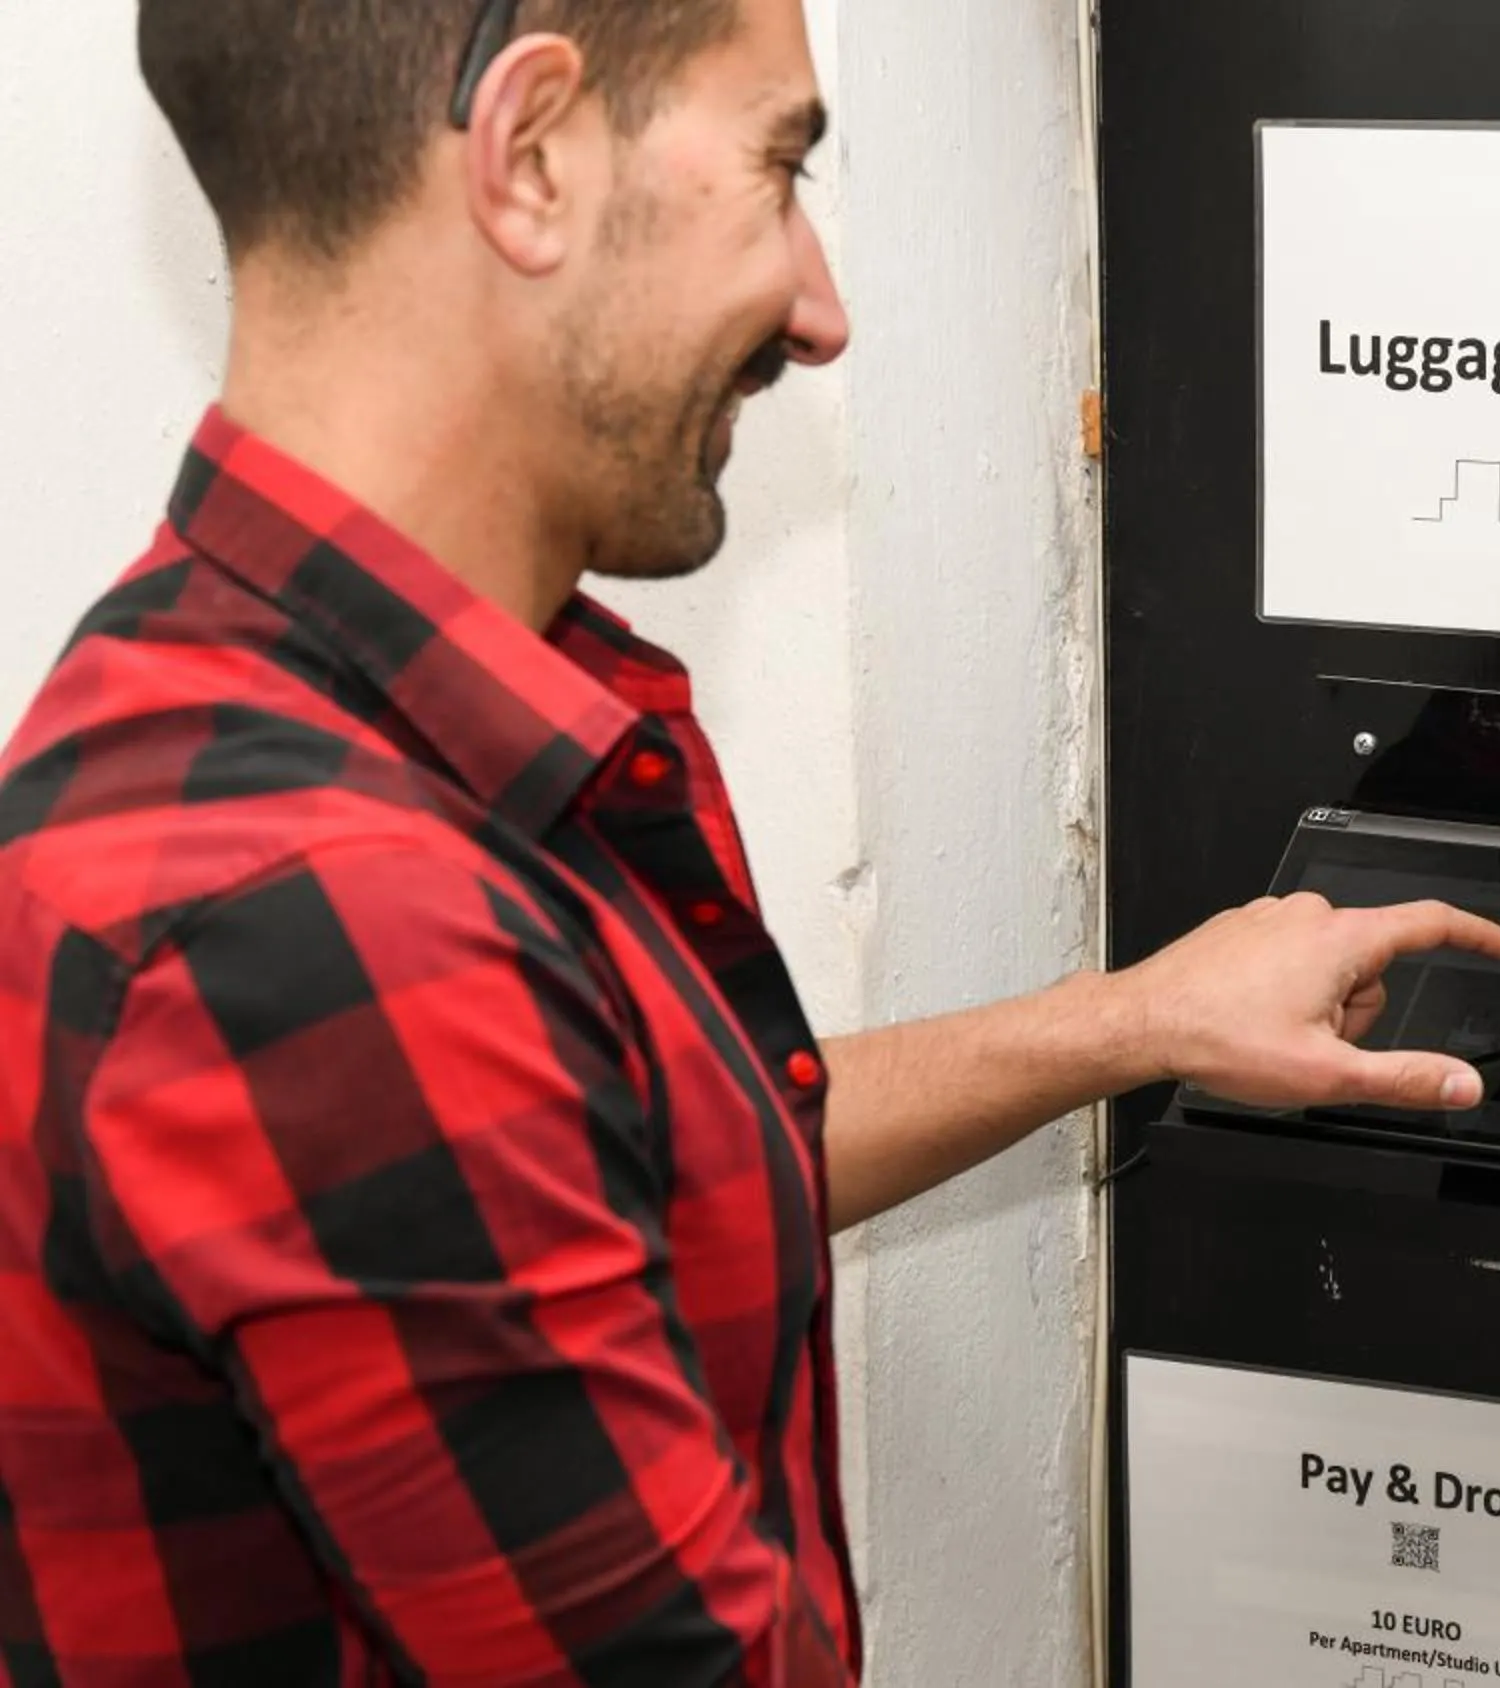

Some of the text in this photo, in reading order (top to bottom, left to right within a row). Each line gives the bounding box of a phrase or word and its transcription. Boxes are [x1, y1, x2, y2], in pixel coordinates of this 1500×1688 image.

[1301, 1452, 1374, 1507] Pay
[1385, 1463, 1420, 1505] &
[1371, 1609, 1462, 1642] 10 EURO
[1309, 1631, 1337, 1649] Per
[1340, 1635, 1490, 1675] Apartment/Studio
